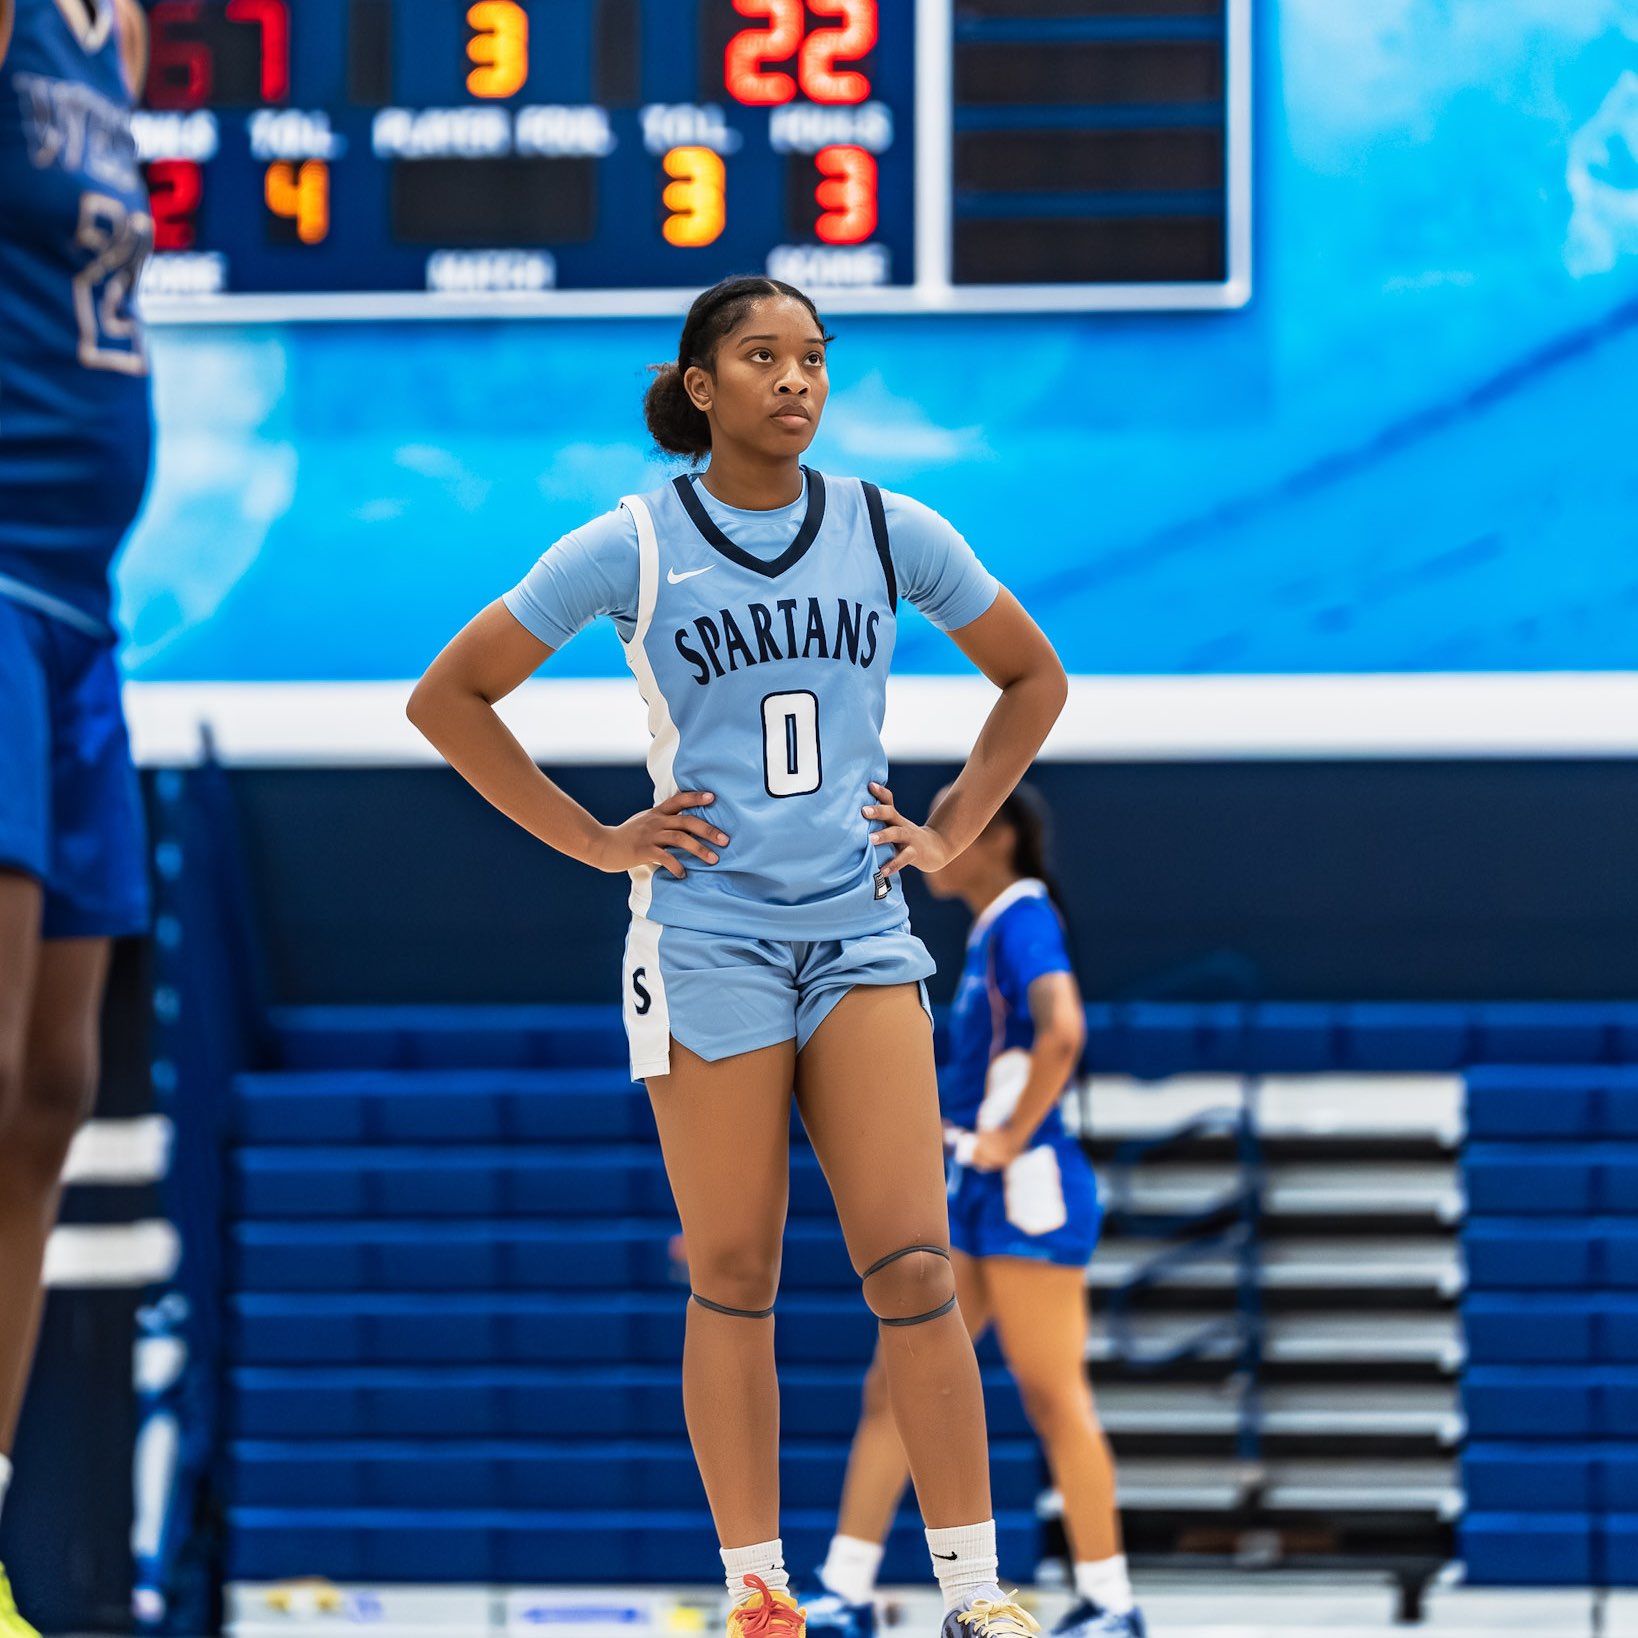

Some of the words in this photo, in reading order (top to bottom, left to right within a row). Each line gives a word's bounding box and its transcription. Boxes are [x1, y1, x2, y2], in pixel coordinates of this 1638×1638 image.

[466, 0, 529, 98] 3
[724, 0, 878, 105] 22
[264, 159, 329, 244] 4
[662, 146, 726, 247] 3
[814, 144, 877, 245] 3
[674, 597, 880, 686] SPARTANS
[761, 689, 823, 798] 0
[632, 967, 652, 1016] S
